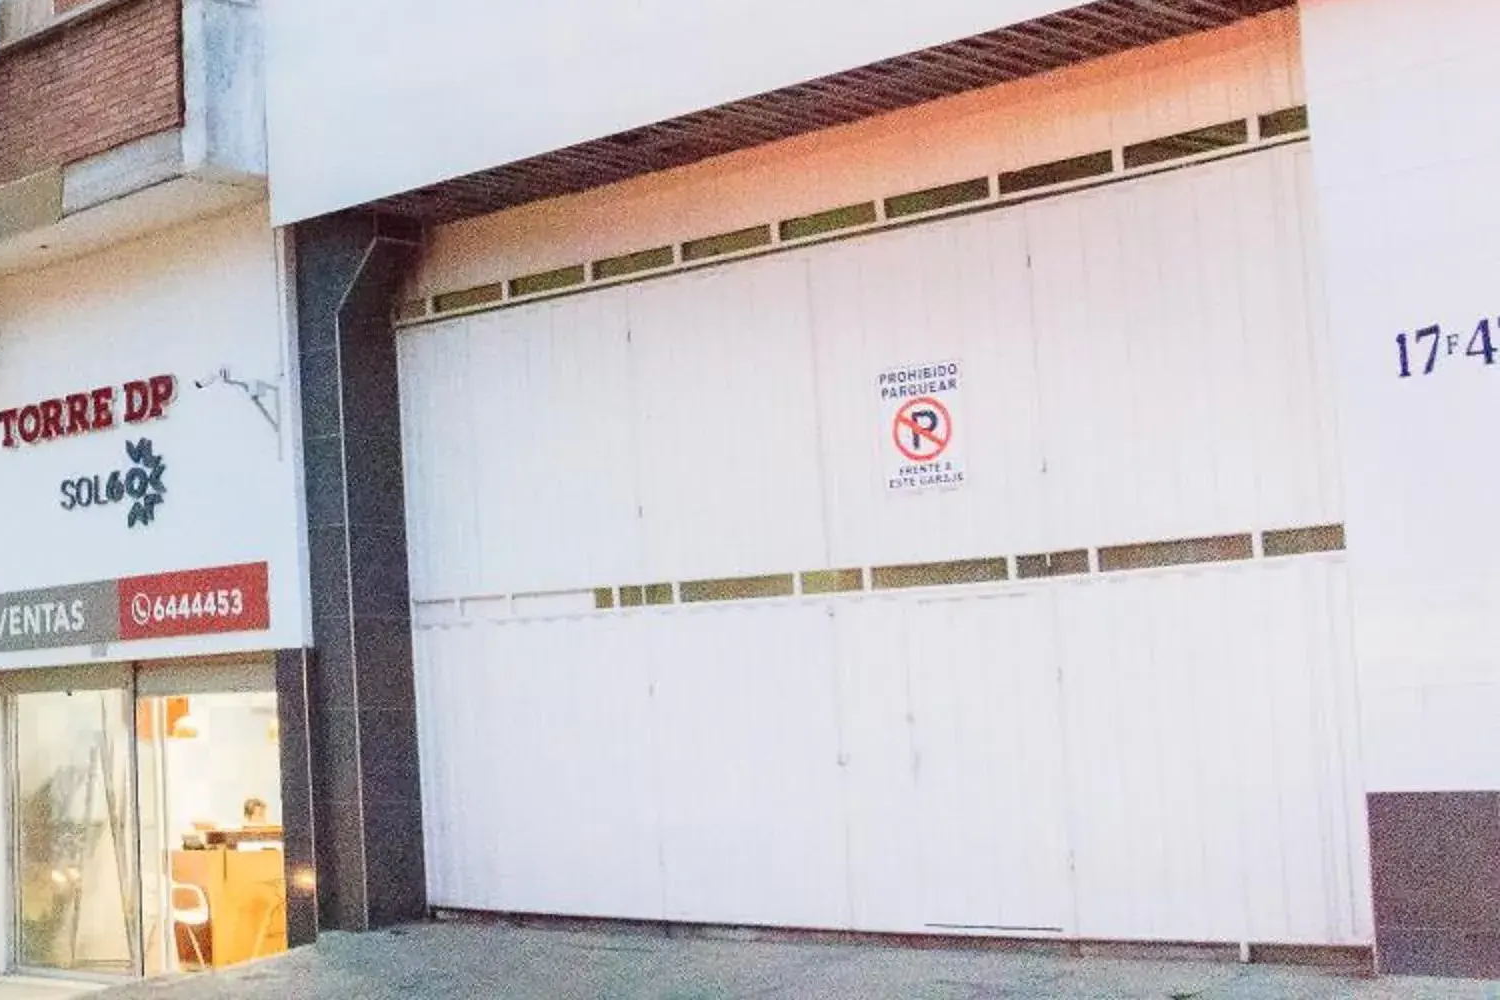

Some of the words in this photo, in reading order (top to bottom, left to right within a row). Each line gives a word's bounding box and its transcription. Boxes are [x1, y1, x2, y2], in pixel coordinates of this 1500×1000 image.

[879, 363, 958, 385] PROHIBIDO
[123, 374, 176, 423] DP
[881, 378, 958, 401] PARQUEAR
[889, 475, 916, 489] ESTE
[919, 471, 965, 487] GARAJE
[899, 463, 941, 477] FRENTE
[153, 588, 244, 621] 6444453
